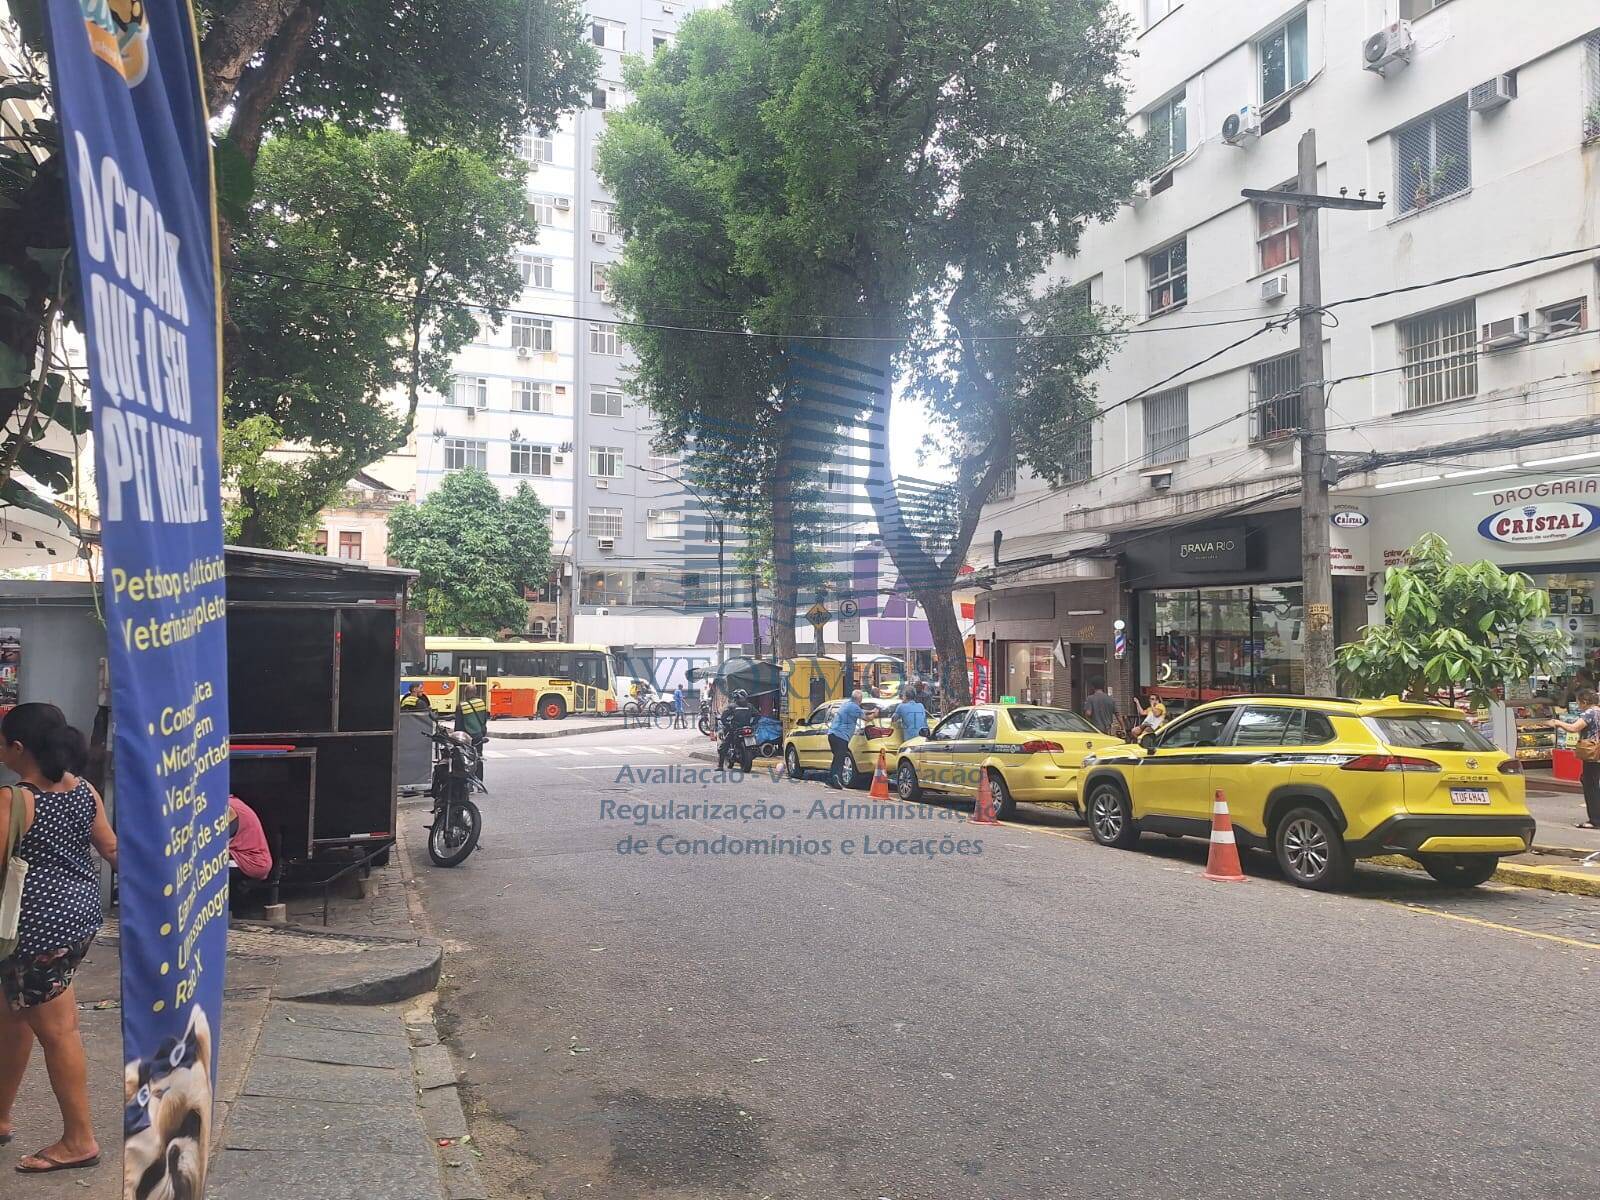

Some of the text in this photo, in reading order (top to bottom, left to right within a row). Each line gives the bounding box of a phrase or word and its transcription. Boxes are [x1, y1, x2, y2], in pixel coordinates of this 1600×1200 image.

[92, 273, 147, 409] QUE
[143, 307, 164, 414] O
[101, 406, 154, 521] PET
[1493, 479, 1598, 506] DROGARIA
[1496, 513, 1584, 536] CRISTAL
[1180, 543, 1214, 558] BRAVA
[1216, 540, 1235, 551] RIO
[845, 603, 852, 614] E
[197, 824, 212, 849] de
[194, 948, 204, 977] X
